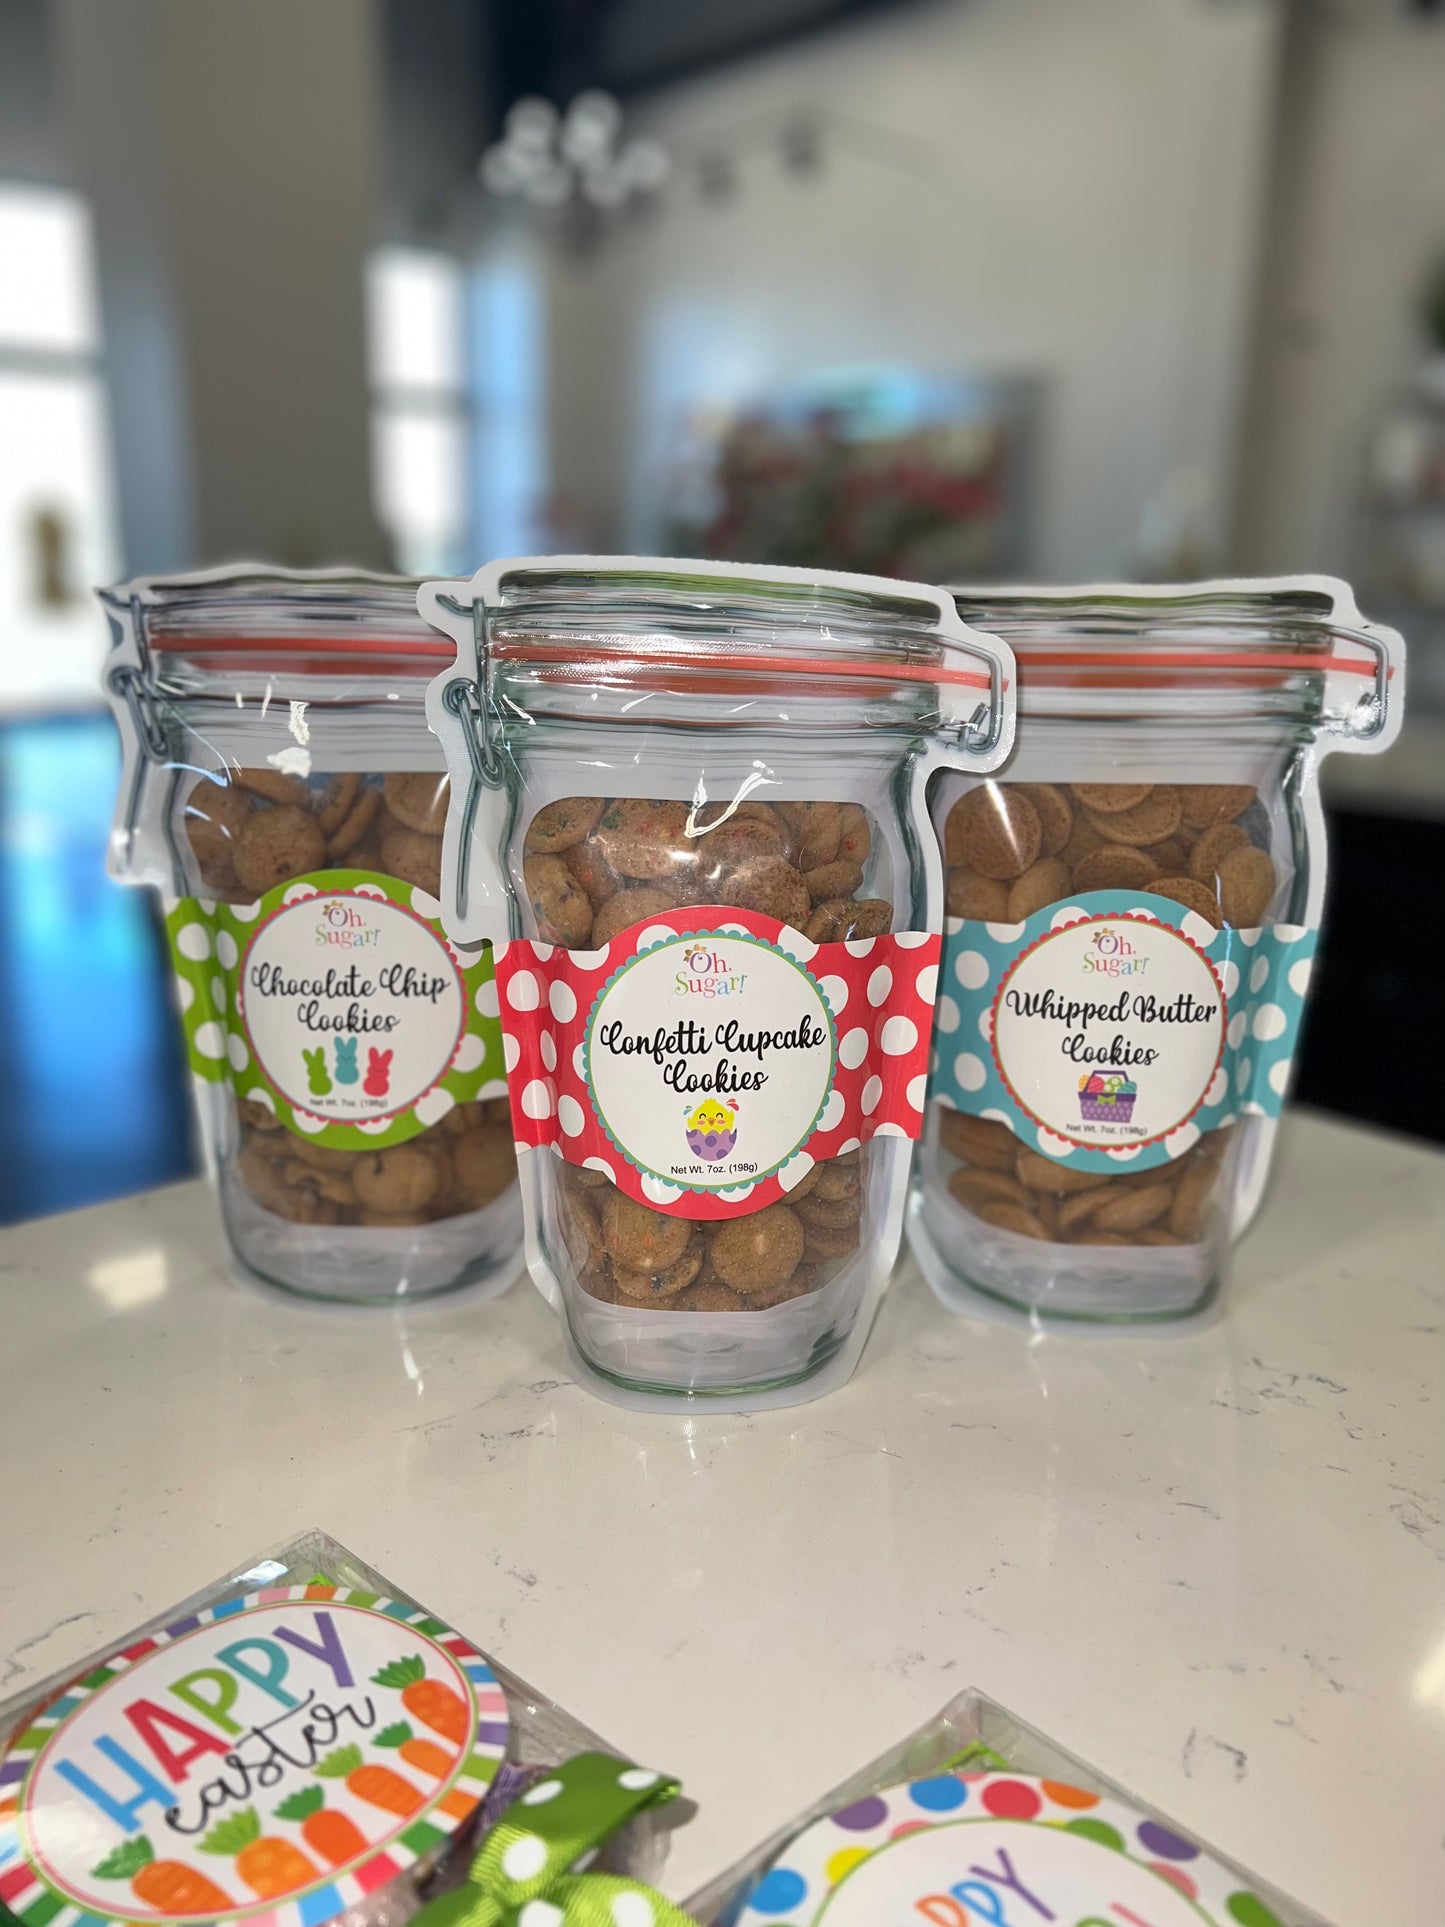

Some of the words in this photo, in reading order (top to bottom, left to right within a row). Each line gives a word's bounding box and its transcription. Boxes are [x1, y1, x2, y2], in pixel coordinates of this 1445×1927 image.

[314, 924, 381, 948] Sugar!
[1081, 951, 1151, 978] Sugar!
[250, 962, 376, 999] Chocolate
[379, 963, 451, 1004] Chip
[674, 971, 748, 998] Sugar!
[297, 1000, 400, 1033] Cookies
[1005, 989, 1132, 1030] Whipped
[1132, 993, 1218, 1024] Butter
[600, 1020, 713, 1065] Confetti
[715, 1014, 826, 1061] Cupcake
[1061, 1033, 1160, 1066] Cookies
[663, 1058, 769, 1094] Cookies
[1066, 1124, 1081, 1132] Net
[670, 1166, 687, 1175] Net
[689, 1165, 705, 1175] Wt.
[707, 1164, 727, 1174] 7oz.
[729, 1162, 758, 1174] (198g)
[53, 1611, 355, 1833] HAPPY
